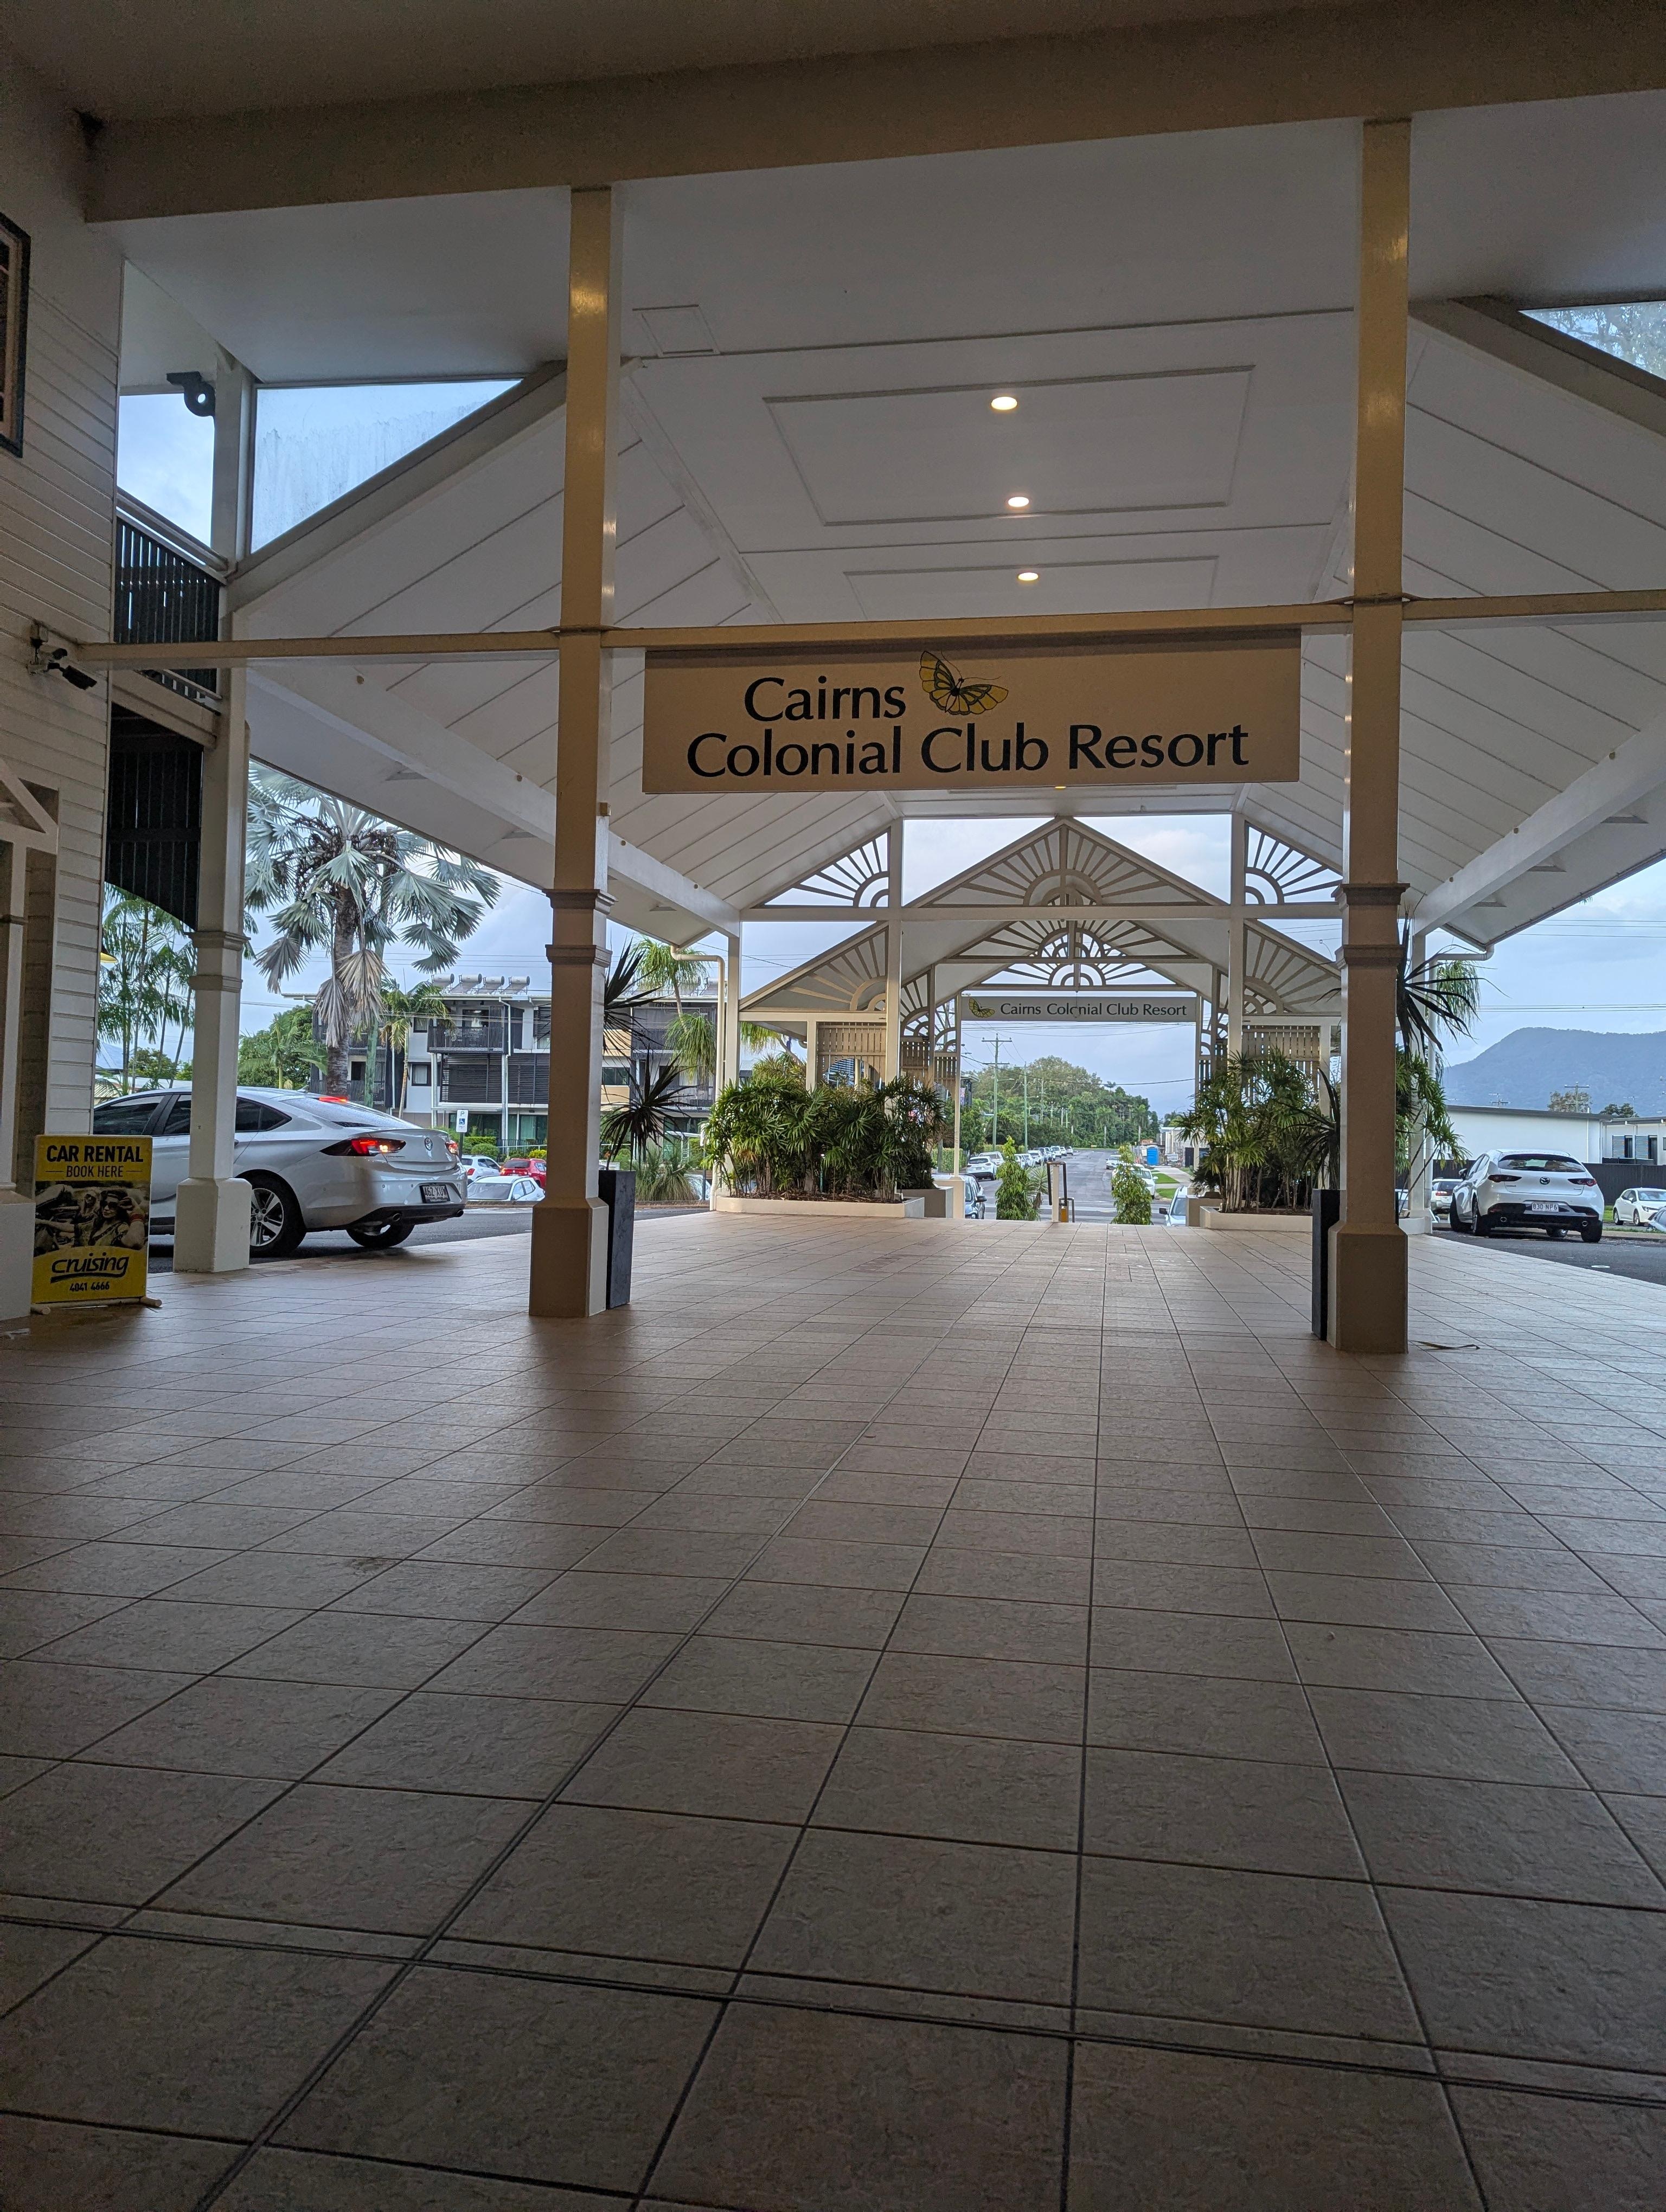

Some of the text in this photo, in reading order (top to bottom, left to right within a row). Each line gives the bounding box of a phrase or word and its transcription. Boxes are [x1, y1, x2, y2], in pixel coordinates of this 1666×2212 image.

[744, 676, 906, 723] Cairns
[687, 721, 1249, 777] Colonial Club Resort
[1000, 1002, 1187, 1016] Cairns Colonial Club Resort
[47, 1145, 144, 1162] CAR RENTAL
[66, 1166, 124, 1178] BOOK HERE
[69, 1282, 110, 1291] 4041 4666
